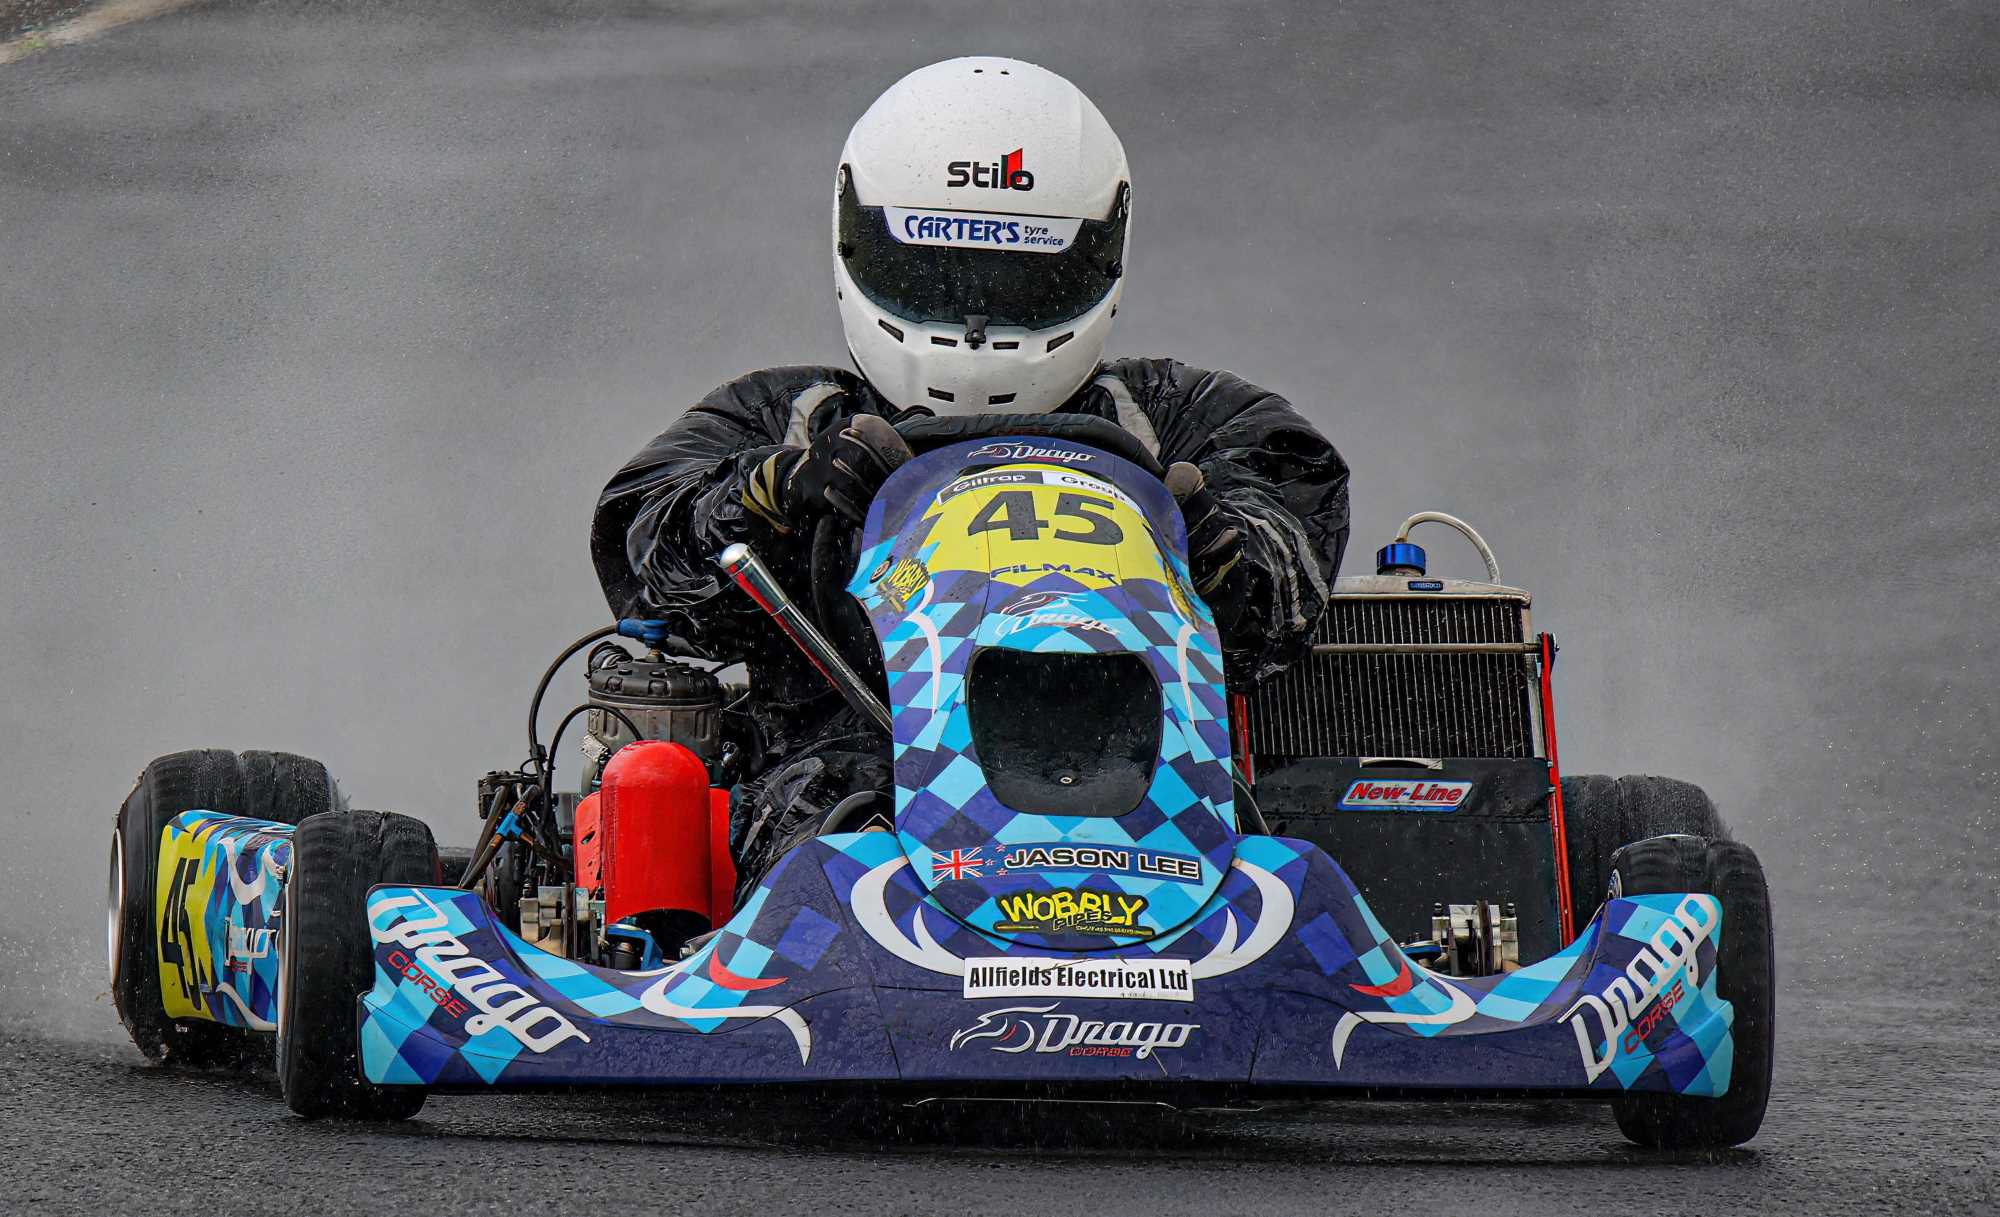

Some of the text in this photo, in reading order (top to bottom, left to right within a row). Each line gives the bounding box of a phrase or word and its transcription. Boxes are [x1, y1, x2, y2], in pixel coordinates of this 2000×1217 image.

[946, 150, 1035, 192] Stilo
[904, 214, 1020, 244] CARTER'S
[1024, 224, 1049, 236] tyre
[1024, 235, 1064, 247] service
[1011, 444, 1097, 463] Drago
[967, 490, 1124, 546] 45
[1346, 781, 1464, 802] New-Line
[1004, 848, 1200, 878] JASON LEE
[1000, 891, 1144, 927] WOBBLY
[1052, 910, 1113, 932] PIPES
[160, 857, 202, 1012] 45
[369, 887, 591, 1054] Drago
[386, 949, 470, 1020] CORSE
[969, 966, 1189, 992] Allfields Electrical Ltd
[1557, 892, 1718, 1085] Drago
[1623, 979, 1687, 1055] CORSE
[1035, 1014, 1201, 1060] Drago
